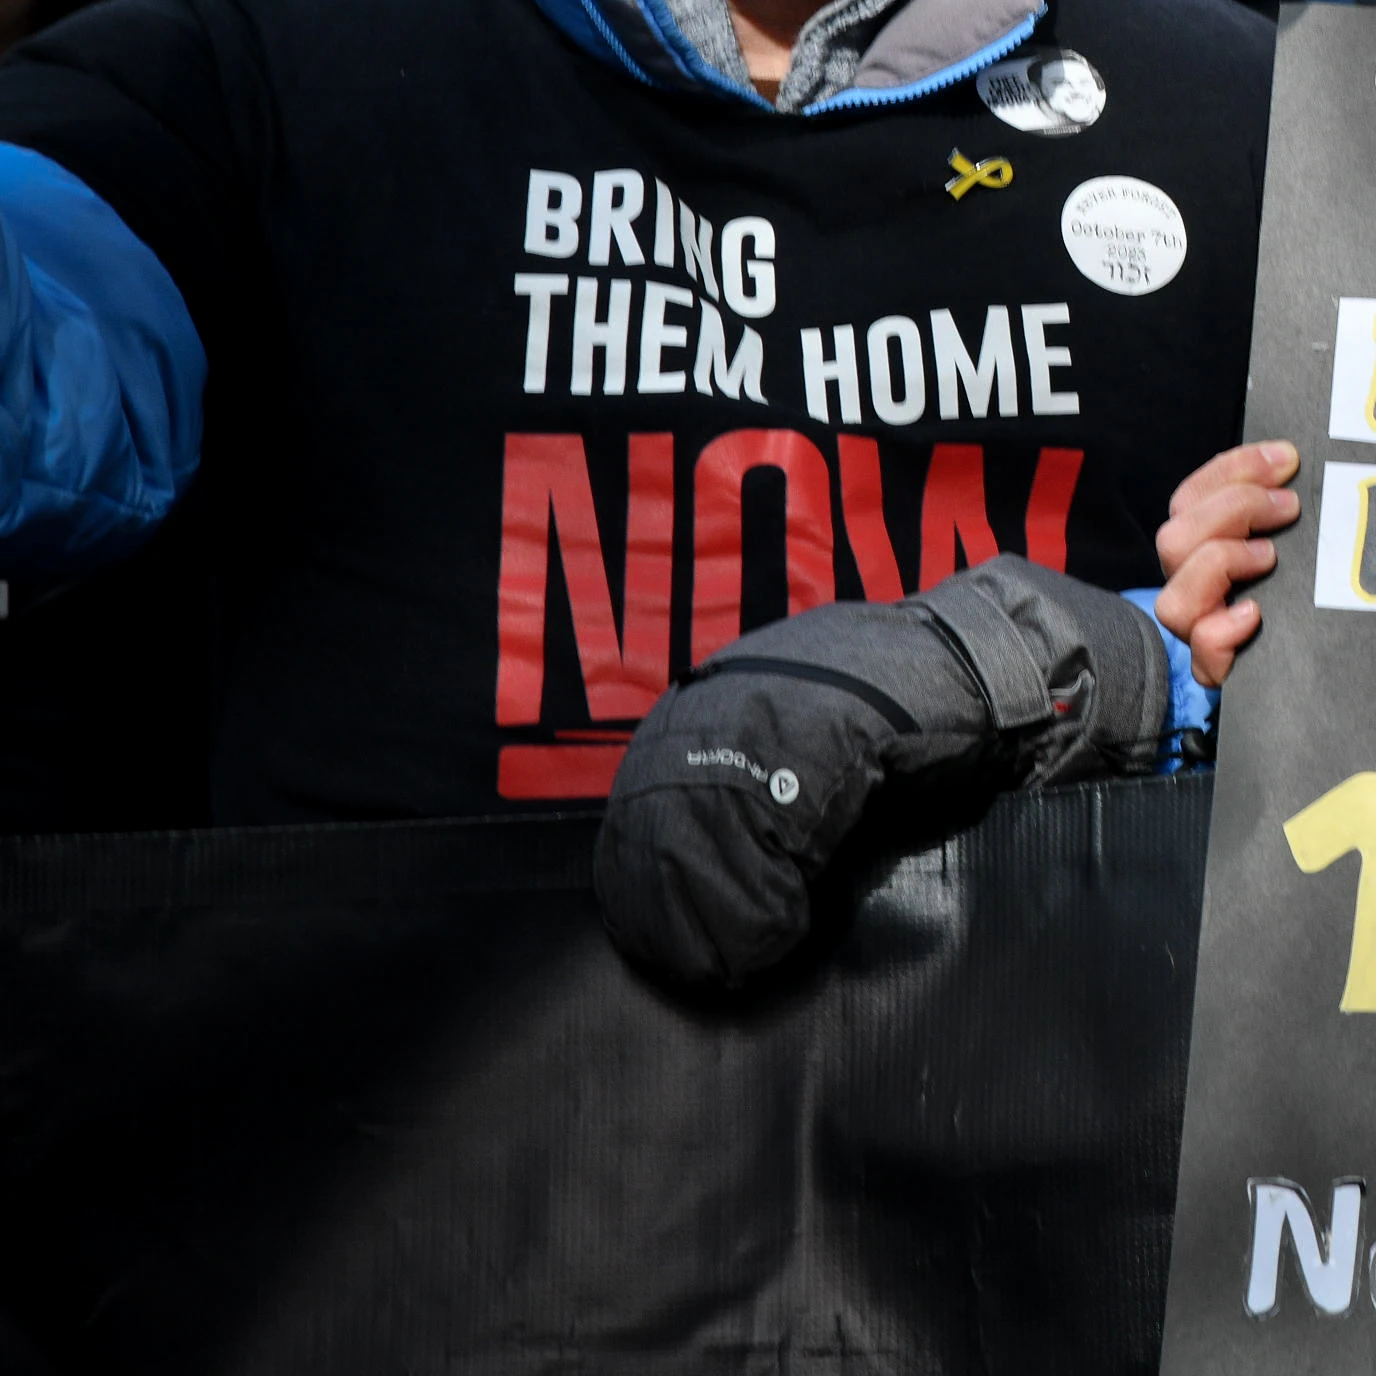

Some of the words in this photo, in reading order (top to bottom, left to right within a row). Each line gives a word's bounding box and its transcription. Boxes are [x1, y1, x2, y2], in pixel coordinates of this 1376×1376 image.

[523, 168, 776, 319] BRING
[1070, 219, 1146, 244] October
[1150, 228, 1184, 250] 7th
[514, 272, 769, 407] THEM
[800, 302, 1081, 426] HOME
